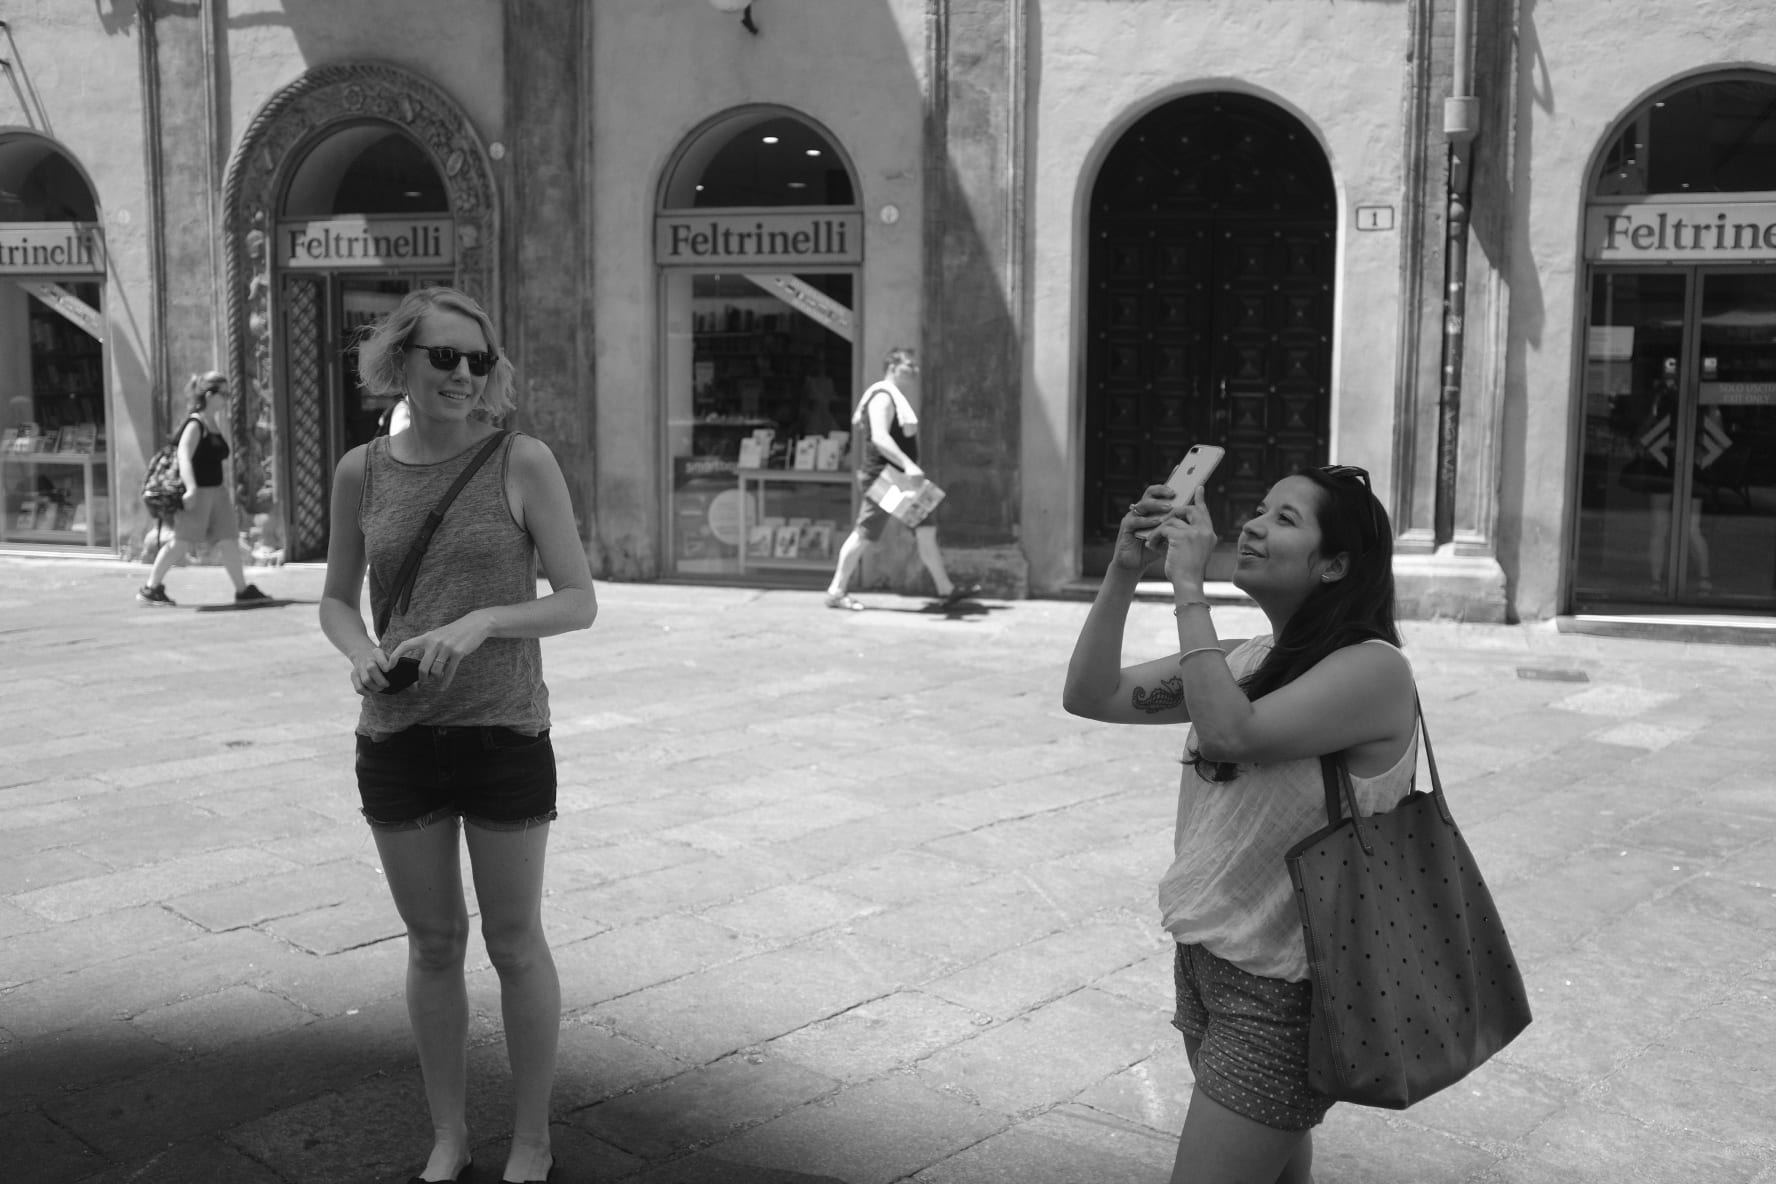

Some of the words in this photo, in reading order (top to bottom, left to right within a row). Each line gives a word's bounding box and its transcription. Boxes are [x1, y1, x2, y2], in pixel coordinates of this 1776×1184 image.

[1371, 211, 1378, 226] 1
[287, 225, 442, 259] Feltrinelli
[669, 220, 848, 256] Feltrinelli
